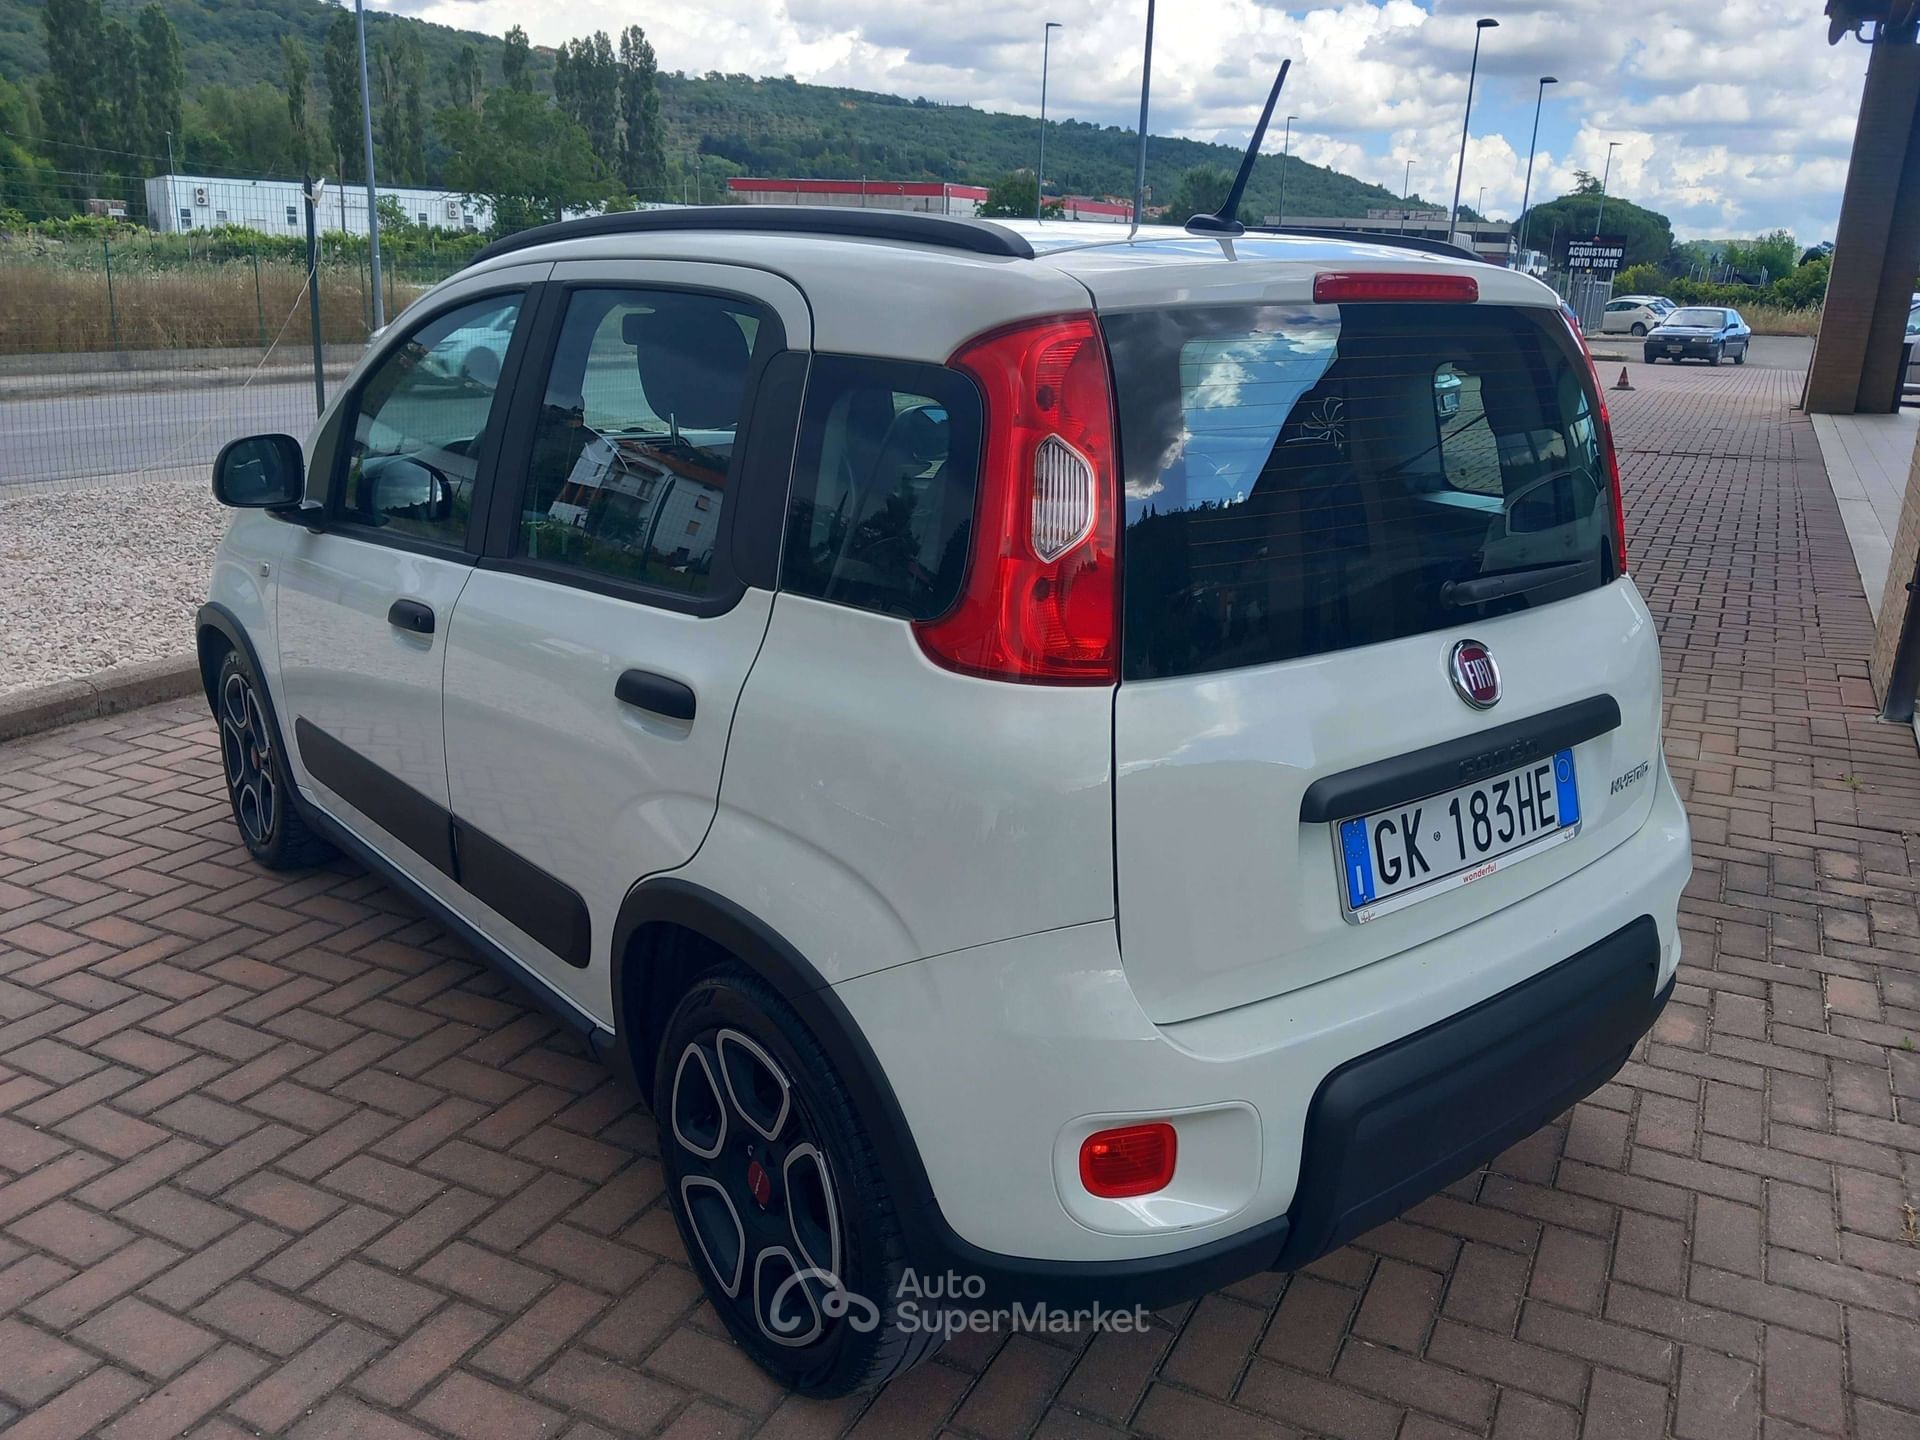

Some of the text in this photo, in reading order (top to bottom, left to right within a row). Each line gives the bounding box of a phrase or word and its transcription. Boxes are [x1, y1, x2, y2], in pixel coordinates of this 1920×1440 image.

[1568, 247, 1623, 258] ACQUISTIAMO
[1569, 258, 1619, 268] AUTO USATE
[1464, 657, 1494, 691] FIAT
[1374, 764, 1556, 885] GK 183HE
[1463, 862, 1497, 882] wonderful
